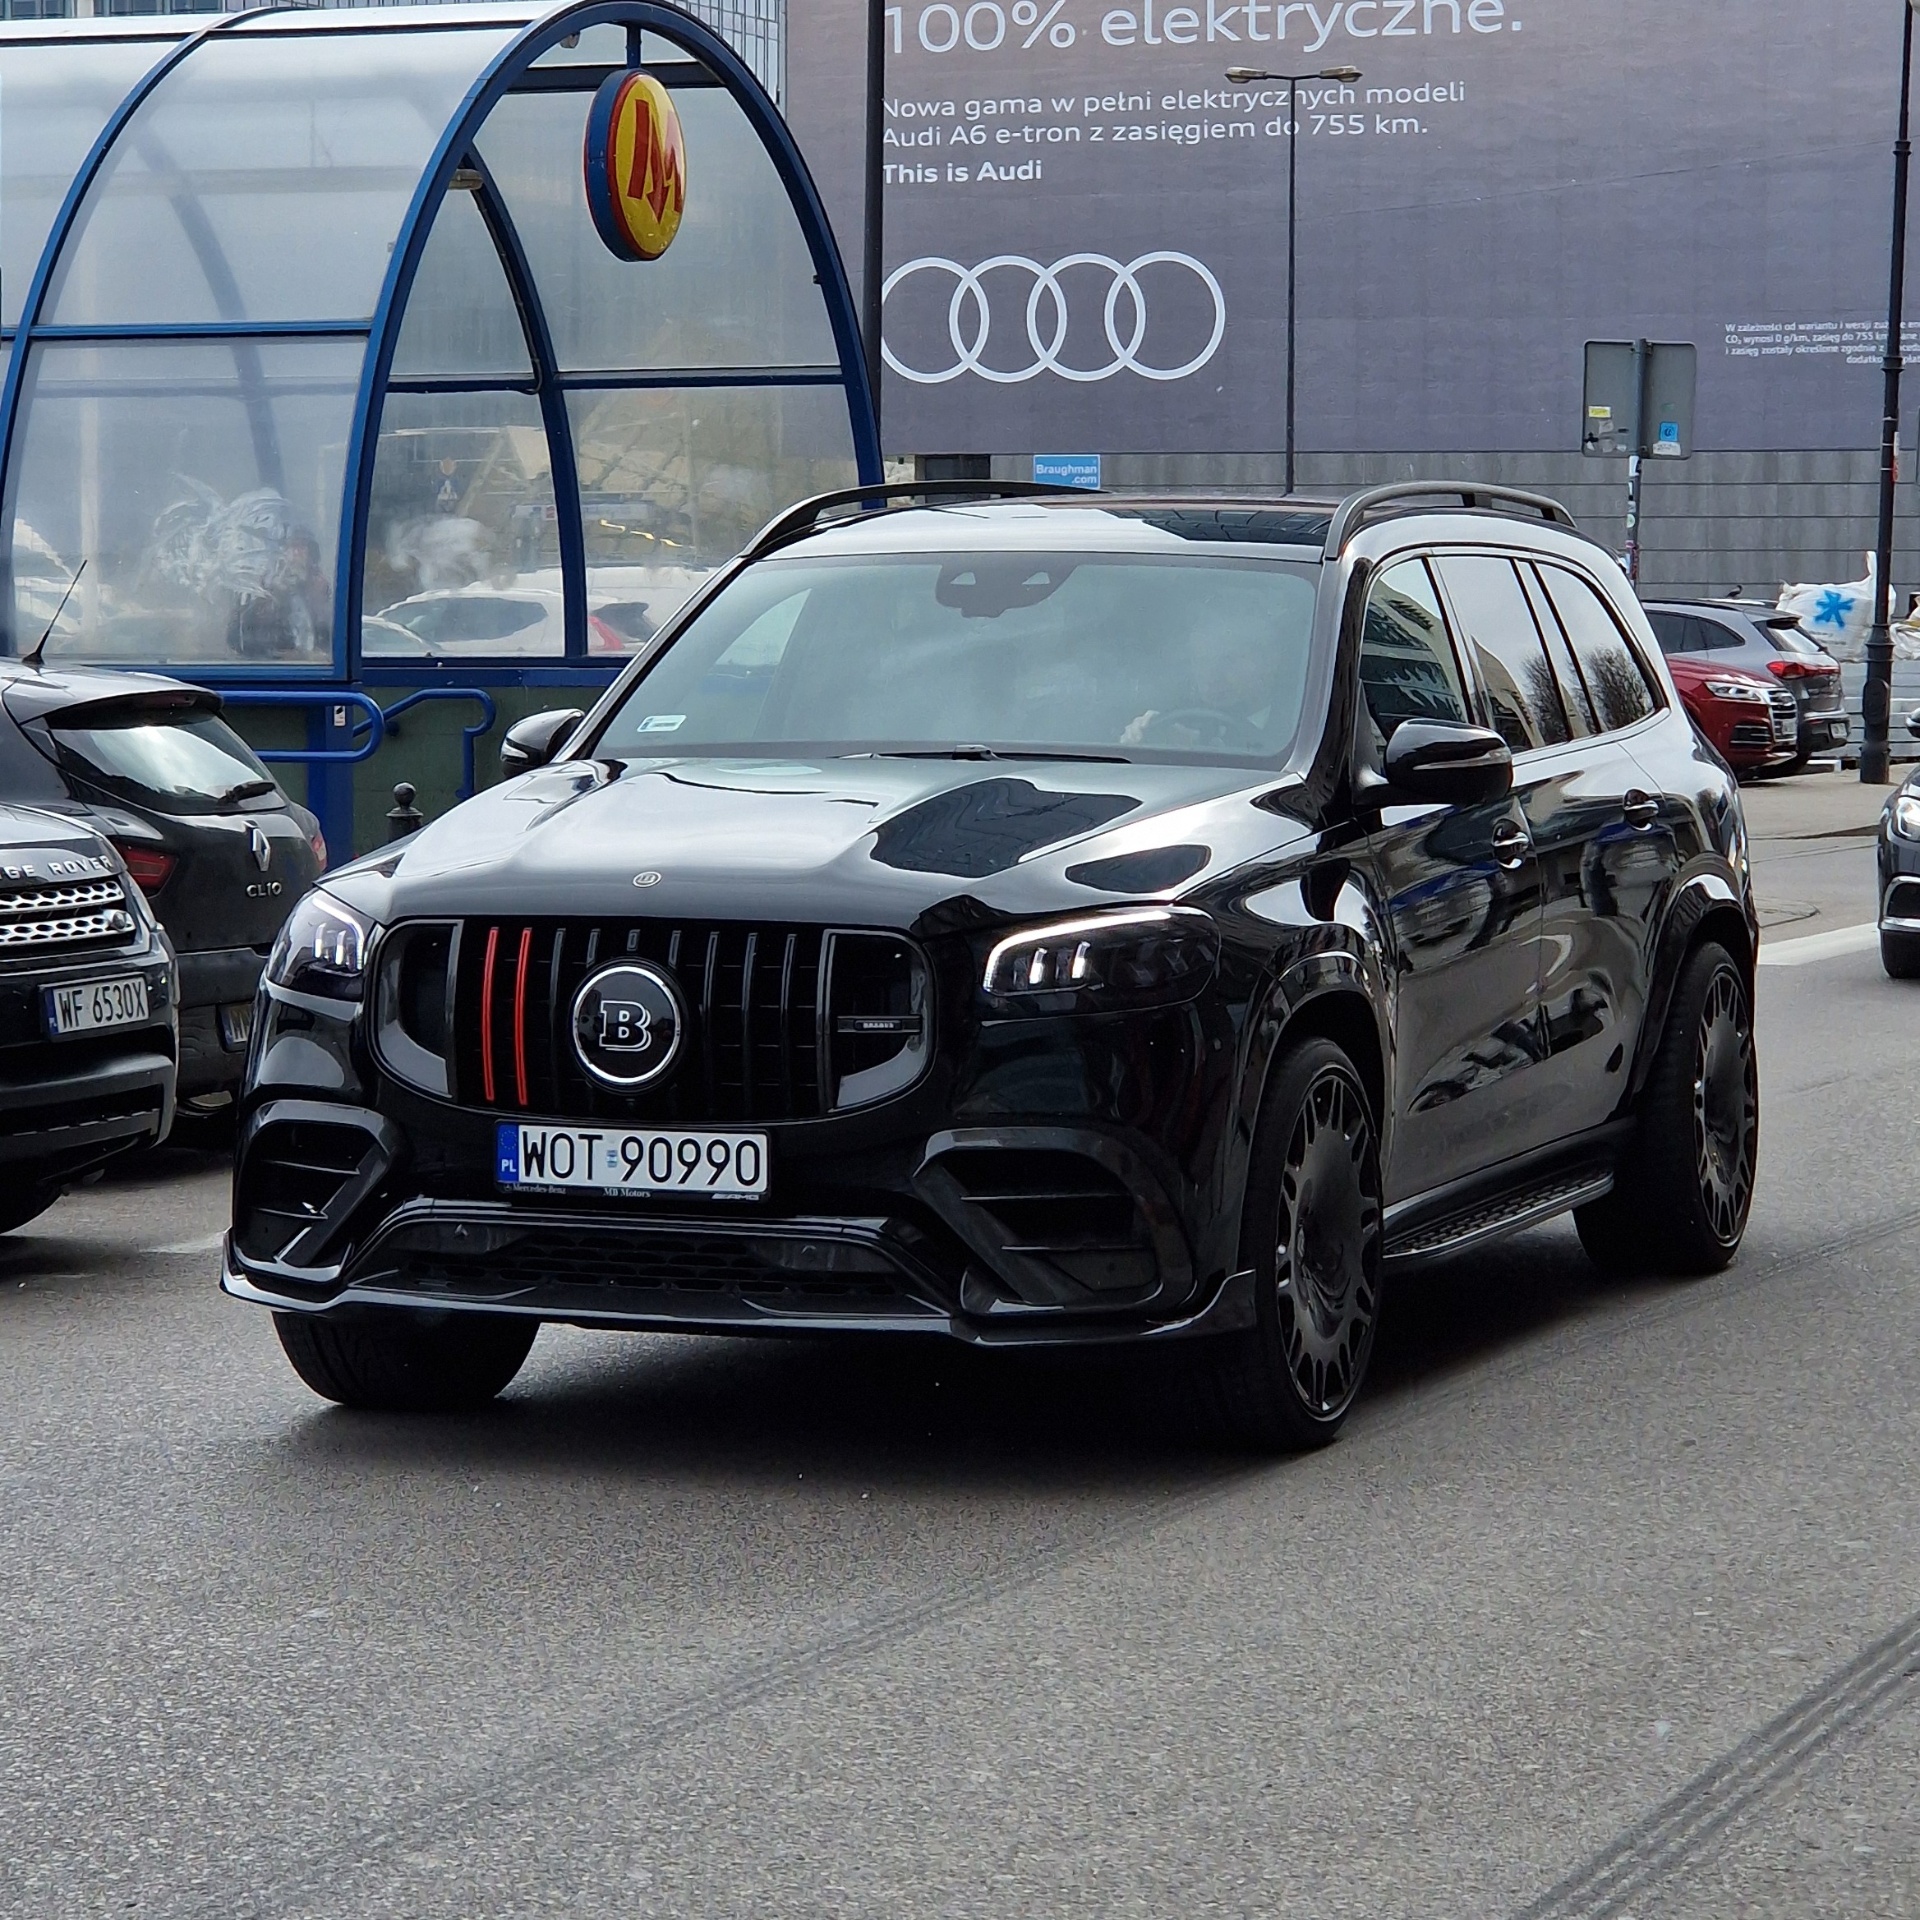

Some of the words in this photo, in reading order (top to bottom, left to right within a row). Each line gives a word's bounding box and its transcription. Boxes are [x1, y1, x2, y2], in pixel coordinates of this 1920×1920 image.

[885, 0, 1076, 53] 100%
[1101, 0, 1521, 53] elektryczne.
[884, 98, 955, 118] Nowa
[965, 98, 1042, 120] gama
[1051, 97, 1075, 112] w
[1084, 91, 1150, 117] pełni
[1161, 82, 1355, 112] elektrycznych
[1366, 81, 1465, 104] modeli
[883, 126, 941, 147] Audi
[949, 125, 987, 145] A6
[995, 124, 1080, 143] e-tron
[1089, 126, 1104, 141] z
[1112, 118, 1255, 145] zasięgiem
[1310, 114, 1364, 135] 755
[1376, 115, 1428, 134] km.
[884, 163, 938, 183] This
[947, 163, 969, 182] is
[976, 160, 1042, 181] Audi
[1855, 331, 1873, 340] 755
[1036, 464, 1097, 476] Braughman
[1072, 475, 1097, 484] .com
[50, 855, 115, 875] ROVER
[246, 881, 282, 897] CLIO
[58, 990, 83, 1029] WF
[93, 981, 146, 1023] 6530X
[501, 1159, 517, 1173] PL
[522, 1130, 604, 1180] WOT
[620, 1135, 761, 1186] 90990
